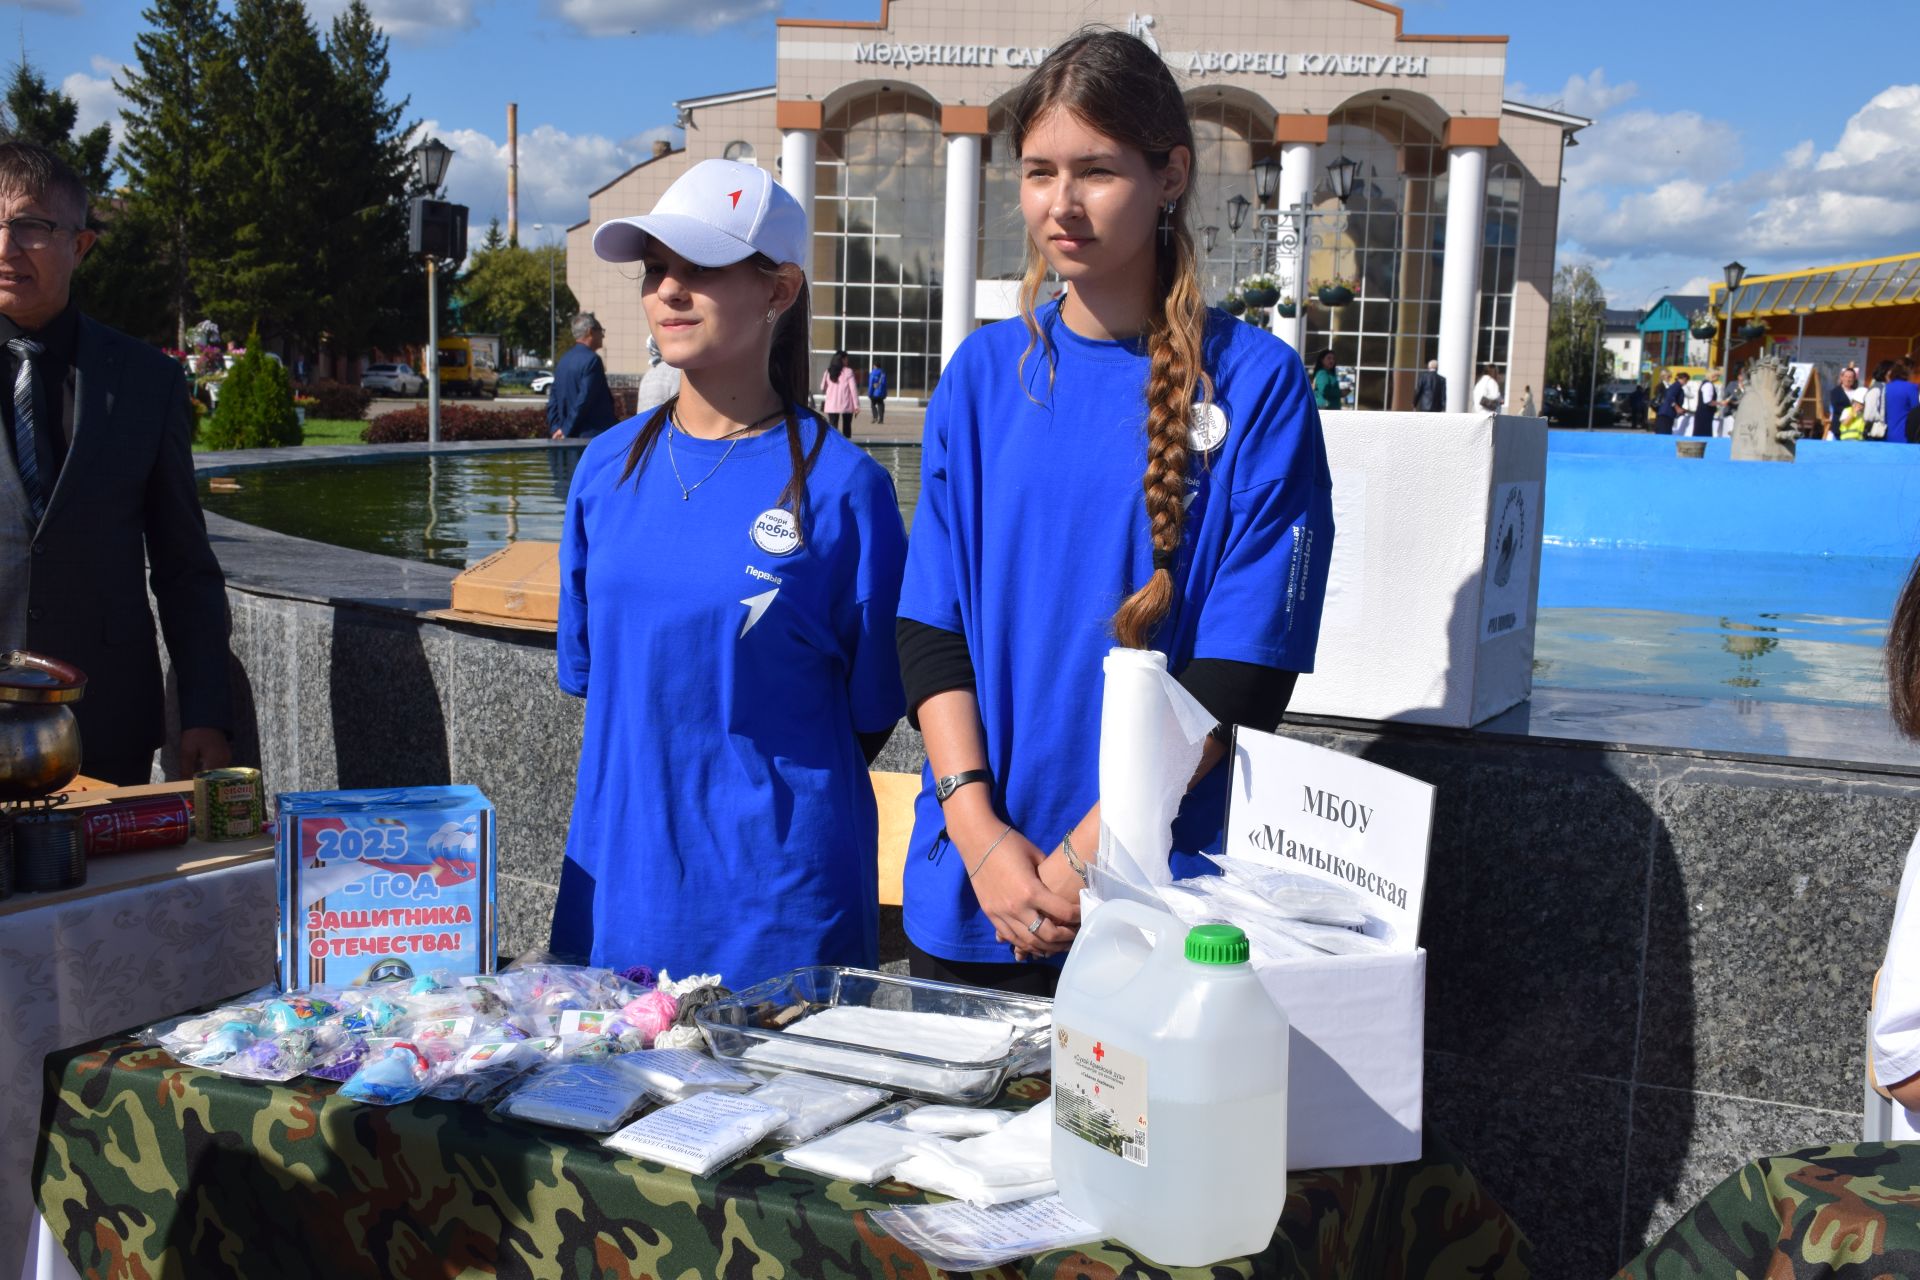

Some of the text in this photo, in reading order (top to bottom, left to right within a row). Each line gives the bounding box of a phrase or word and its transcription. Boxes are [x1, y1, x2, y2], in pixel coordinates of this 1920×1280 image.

[855, 42, 998, 70] МӘДӘНИЯТ
[1188, 51, 1428, 79] ДВОРЕЦ КУЛЬТУРЫ
[756, 520, 797, 540] добро
[764, 513, 788, 526] твори
[745, 565, 783, 585] Первые
[1302, 785, 1374, 834] МБОУ
[315, 828, 408, 861] 2025
[1248, 823, 1408, 911] «Мамыковская
[371, 872, 440, 899] ГОД
[306, 905, 472, 931] ЗАЩИТНИКА
[310, 933, 461, 959] ОТЕЧЕСТВА!
